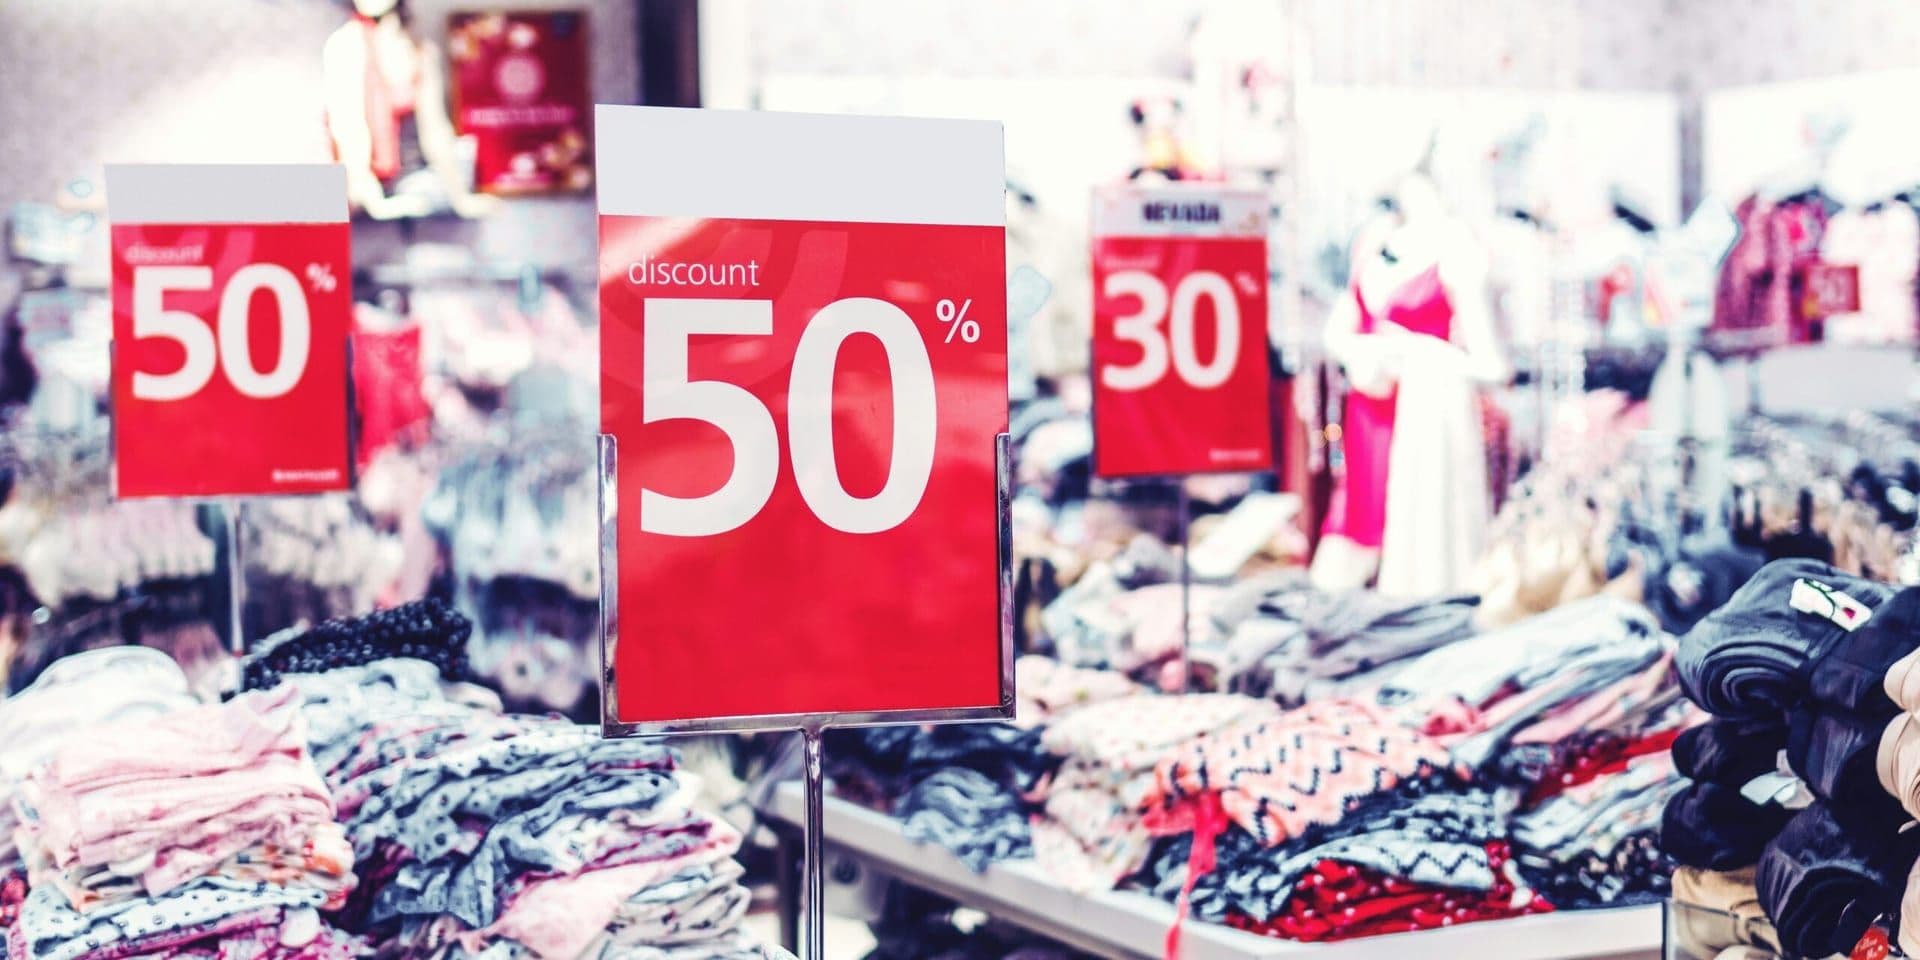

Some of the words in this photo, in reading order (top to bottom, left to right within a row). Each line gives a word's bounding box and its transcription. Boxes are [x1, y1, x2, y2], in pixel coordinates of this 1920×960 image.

[132, 264, 310, 401] 50
[628, 254, 760, 287] discount
[1102, 270, 1240, 390] 30
[640, 297, 938, 537] 50
